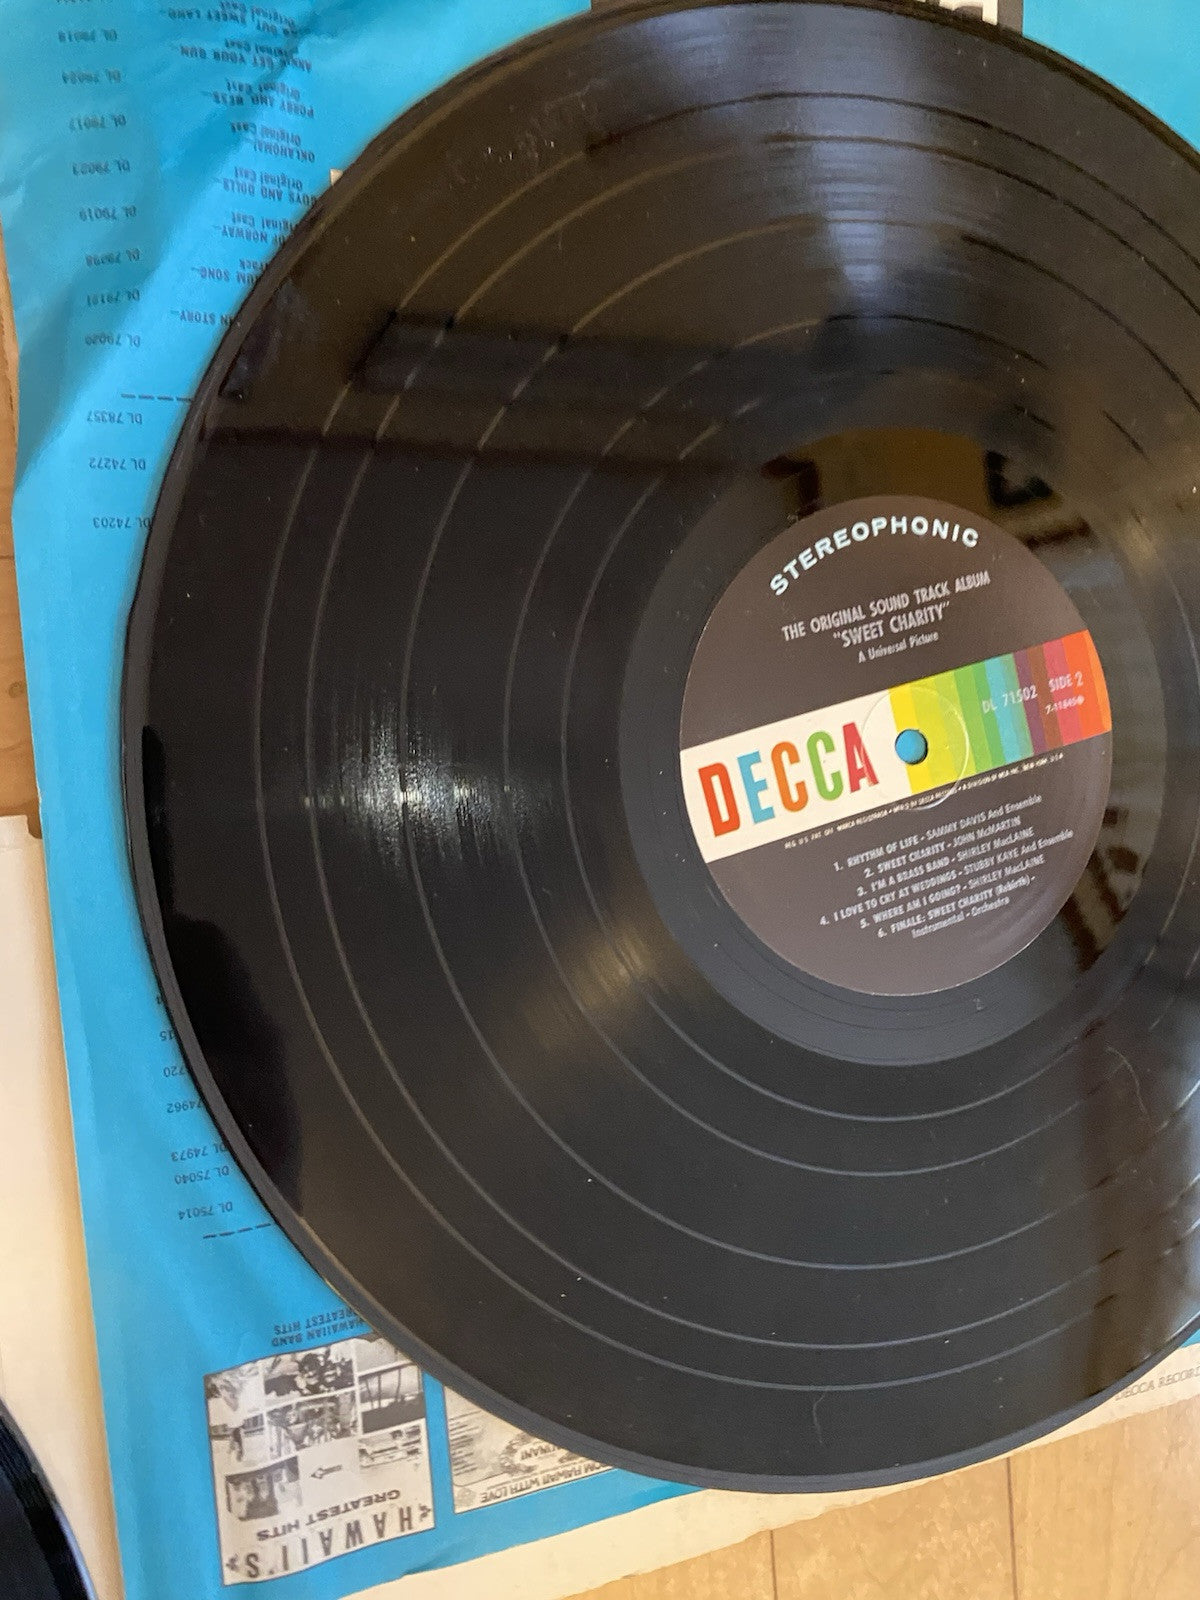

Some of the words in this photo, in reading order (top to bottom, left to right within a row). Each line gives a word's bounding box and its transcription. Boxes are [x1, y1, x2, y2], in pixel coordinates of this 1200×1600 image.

[233, 166, 256, 181] Cast
[260, 172, 302, 190] Original
[261, 187, 282, 201] AND
[231, 211, 254, 226] Cast
[261, 217, 292, 231] iginal
[126, 335, 140, 347] DL
[86, 410, 121, 423] 78357
[126, 411, 142, 423] DL
[88, 456, 127, 469] 74272
[130, 457, 145, 470] DL
[92, 515, 131, 528] 74203
[135, 516, 150, 528] DL
[768, 515, 979, 596] STEREOPHONIC
[781, 621, 805, 641] THE
[810, 603, 865, 633] ORIGINAL
[869, 592, 908, 617] SOUND
[913, 580, 950, 604] TRACK
[955, 569, 990, 592] ALBUM
[833, 620, 883, 651] "SWEET
[889, 600, 949, 633] CHARITY"
[858, 650, 865, 663] A
[868, 638, 906, 660] Universal
[908, 629, 938, 647] Picture
[1048, 674, 1072, 691] SIDE
[1075, 671, 1083, 686] 2
[982, 697, 997, 712] DL
[1002, 685, 1037, 705] 71502
[697, 721, 879, 837] DECCA
[833, 859, 843, 872] 1.
[847, 846, 884, 867] RHYTHM
[886, 841, 896, 854] OF
[900, 835, 918, 848] LIFE
[926, 821, 957, 839] SAMMY
[960, 811, 986, 827] DAVIS
[987, 805, 1003, 818] And
[864, 865, 874, 878] 2.
[877, 855, 906, 872] SWEET
[908, 841, 944, 862] CHARITY
[953, 831, 974, 846] JOHN
[977, 816, 1020, 838] McMARTIN
[856, 884, 867, 896] 3.
[889, 874, 895, 885] A
[896, 864, 924, 882] BRASS
[925, 856, 949, 871] BAND
[957, 841, 991, 861] SHIRLEY
[820, 913, 829, 926] 4.
[840, 903, 863, 918] LOVE
[865, 897, 877, 910] TO
[880, 891, 895, 904] CRY
[898, 885, 909, 898] AT
[911, 869, 956, 893] WEDDINGS
[963, 856, 994, 874] STUBBY
[997, 847, 1019, 863] KAYE
[1021, 841, 1036, 854] And
[860, 916, 869, 929] 5.
[872, 904, 904, 923] WHERE
[906, 898, 921, 911] AM
[928, 885, 960, 904] GOING?
[968, 869, 1002, 888] SHIRLEY
[877, 925, 887, 938] 6.
[890, 913, 925, 933] FINALE:
[927, 902, 955, 919] SWEET
[957, 888, 992, 908] CHARITY
[911, 911, 964, 938] Instrumental
[971, 894, 1009, 916] Orchestra
[170, 1145, 208, 1162] 74973
[174, 1168, 210, 1185] 75040
[213, 1164, 229, 1177] DL
[178, 1204, 214, 1221] 75014
[217, 1200, 232, 1213] DL
[273, 1320, 301, 1335] HITS
[271, 1332, 302, 1348] BAND
[481, 1485, 508, 1503] LOVE
[511, 1476, 540, 1494] WITH
[305, 1487, 401, 1525] GREATEST
[256, 1519, 299, 1543] HITS
[244, 1504, 412, 1579] HAWAII'S
